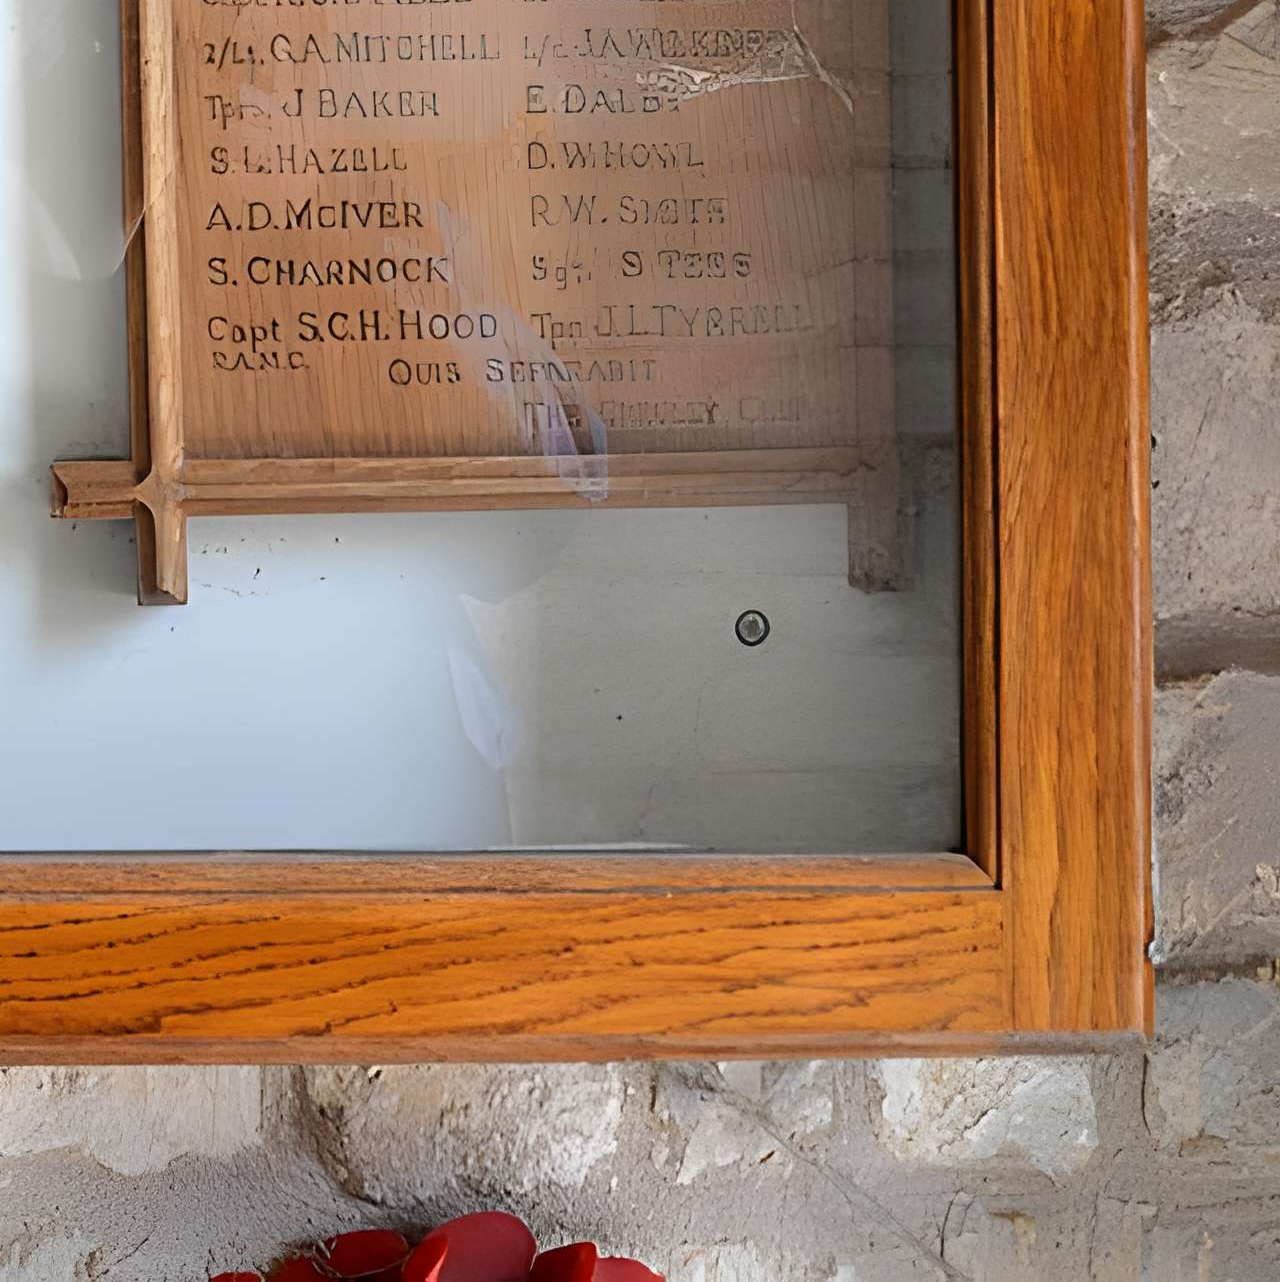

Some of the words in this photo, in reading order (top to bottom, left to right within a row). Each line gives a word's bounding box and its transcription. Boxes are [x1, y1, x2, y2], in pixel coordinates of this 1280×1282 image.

[318, 88, 440, 118] BAKER
[247, 256, 450, 287] CHARNOCK
[207, 316, 282, 353] Capt
[399, 310, 497, 341] HOOD
